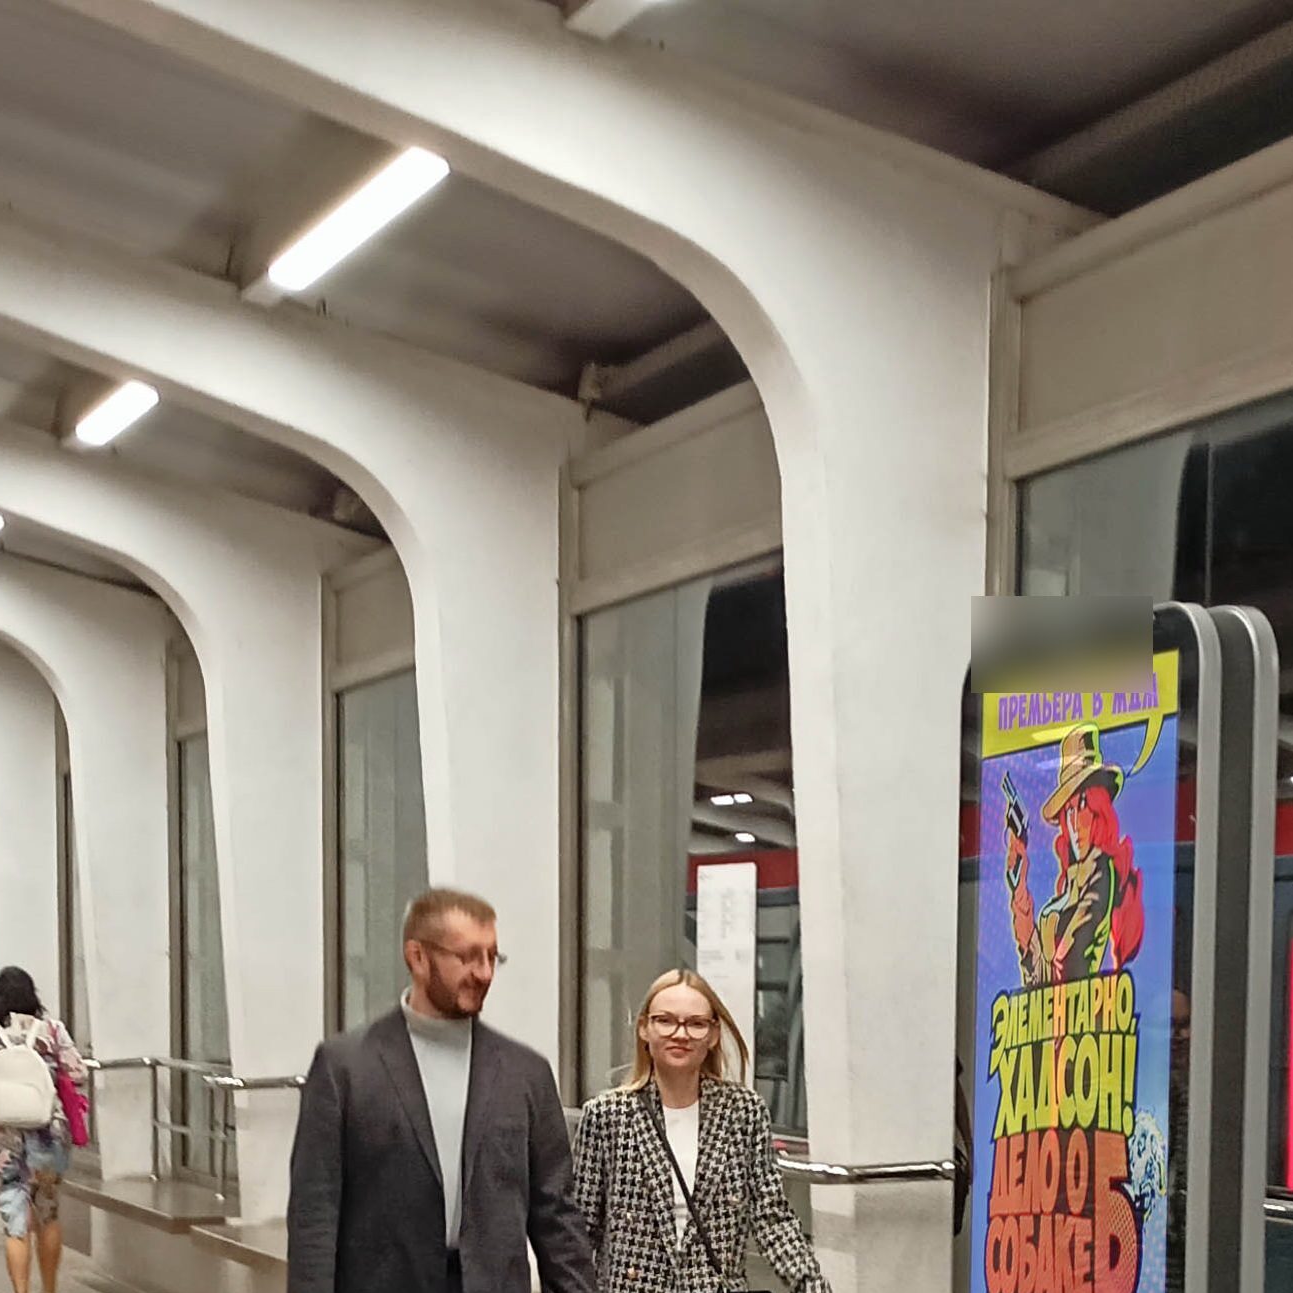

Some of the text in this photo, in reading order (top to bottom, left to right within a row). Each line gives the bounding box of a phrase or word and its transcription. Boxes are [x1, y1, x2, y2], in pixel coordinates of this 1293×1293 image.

[998, 692, 1083, 730] ПРЕМЬЕРА
[989, 972, 1137, 1076] ЭЛЕМЕНТАРНО,
[993, 1033, 1137, 1140] ХАДСОН!
[989, 1127, 1089, 1216] ДЕЛО О
